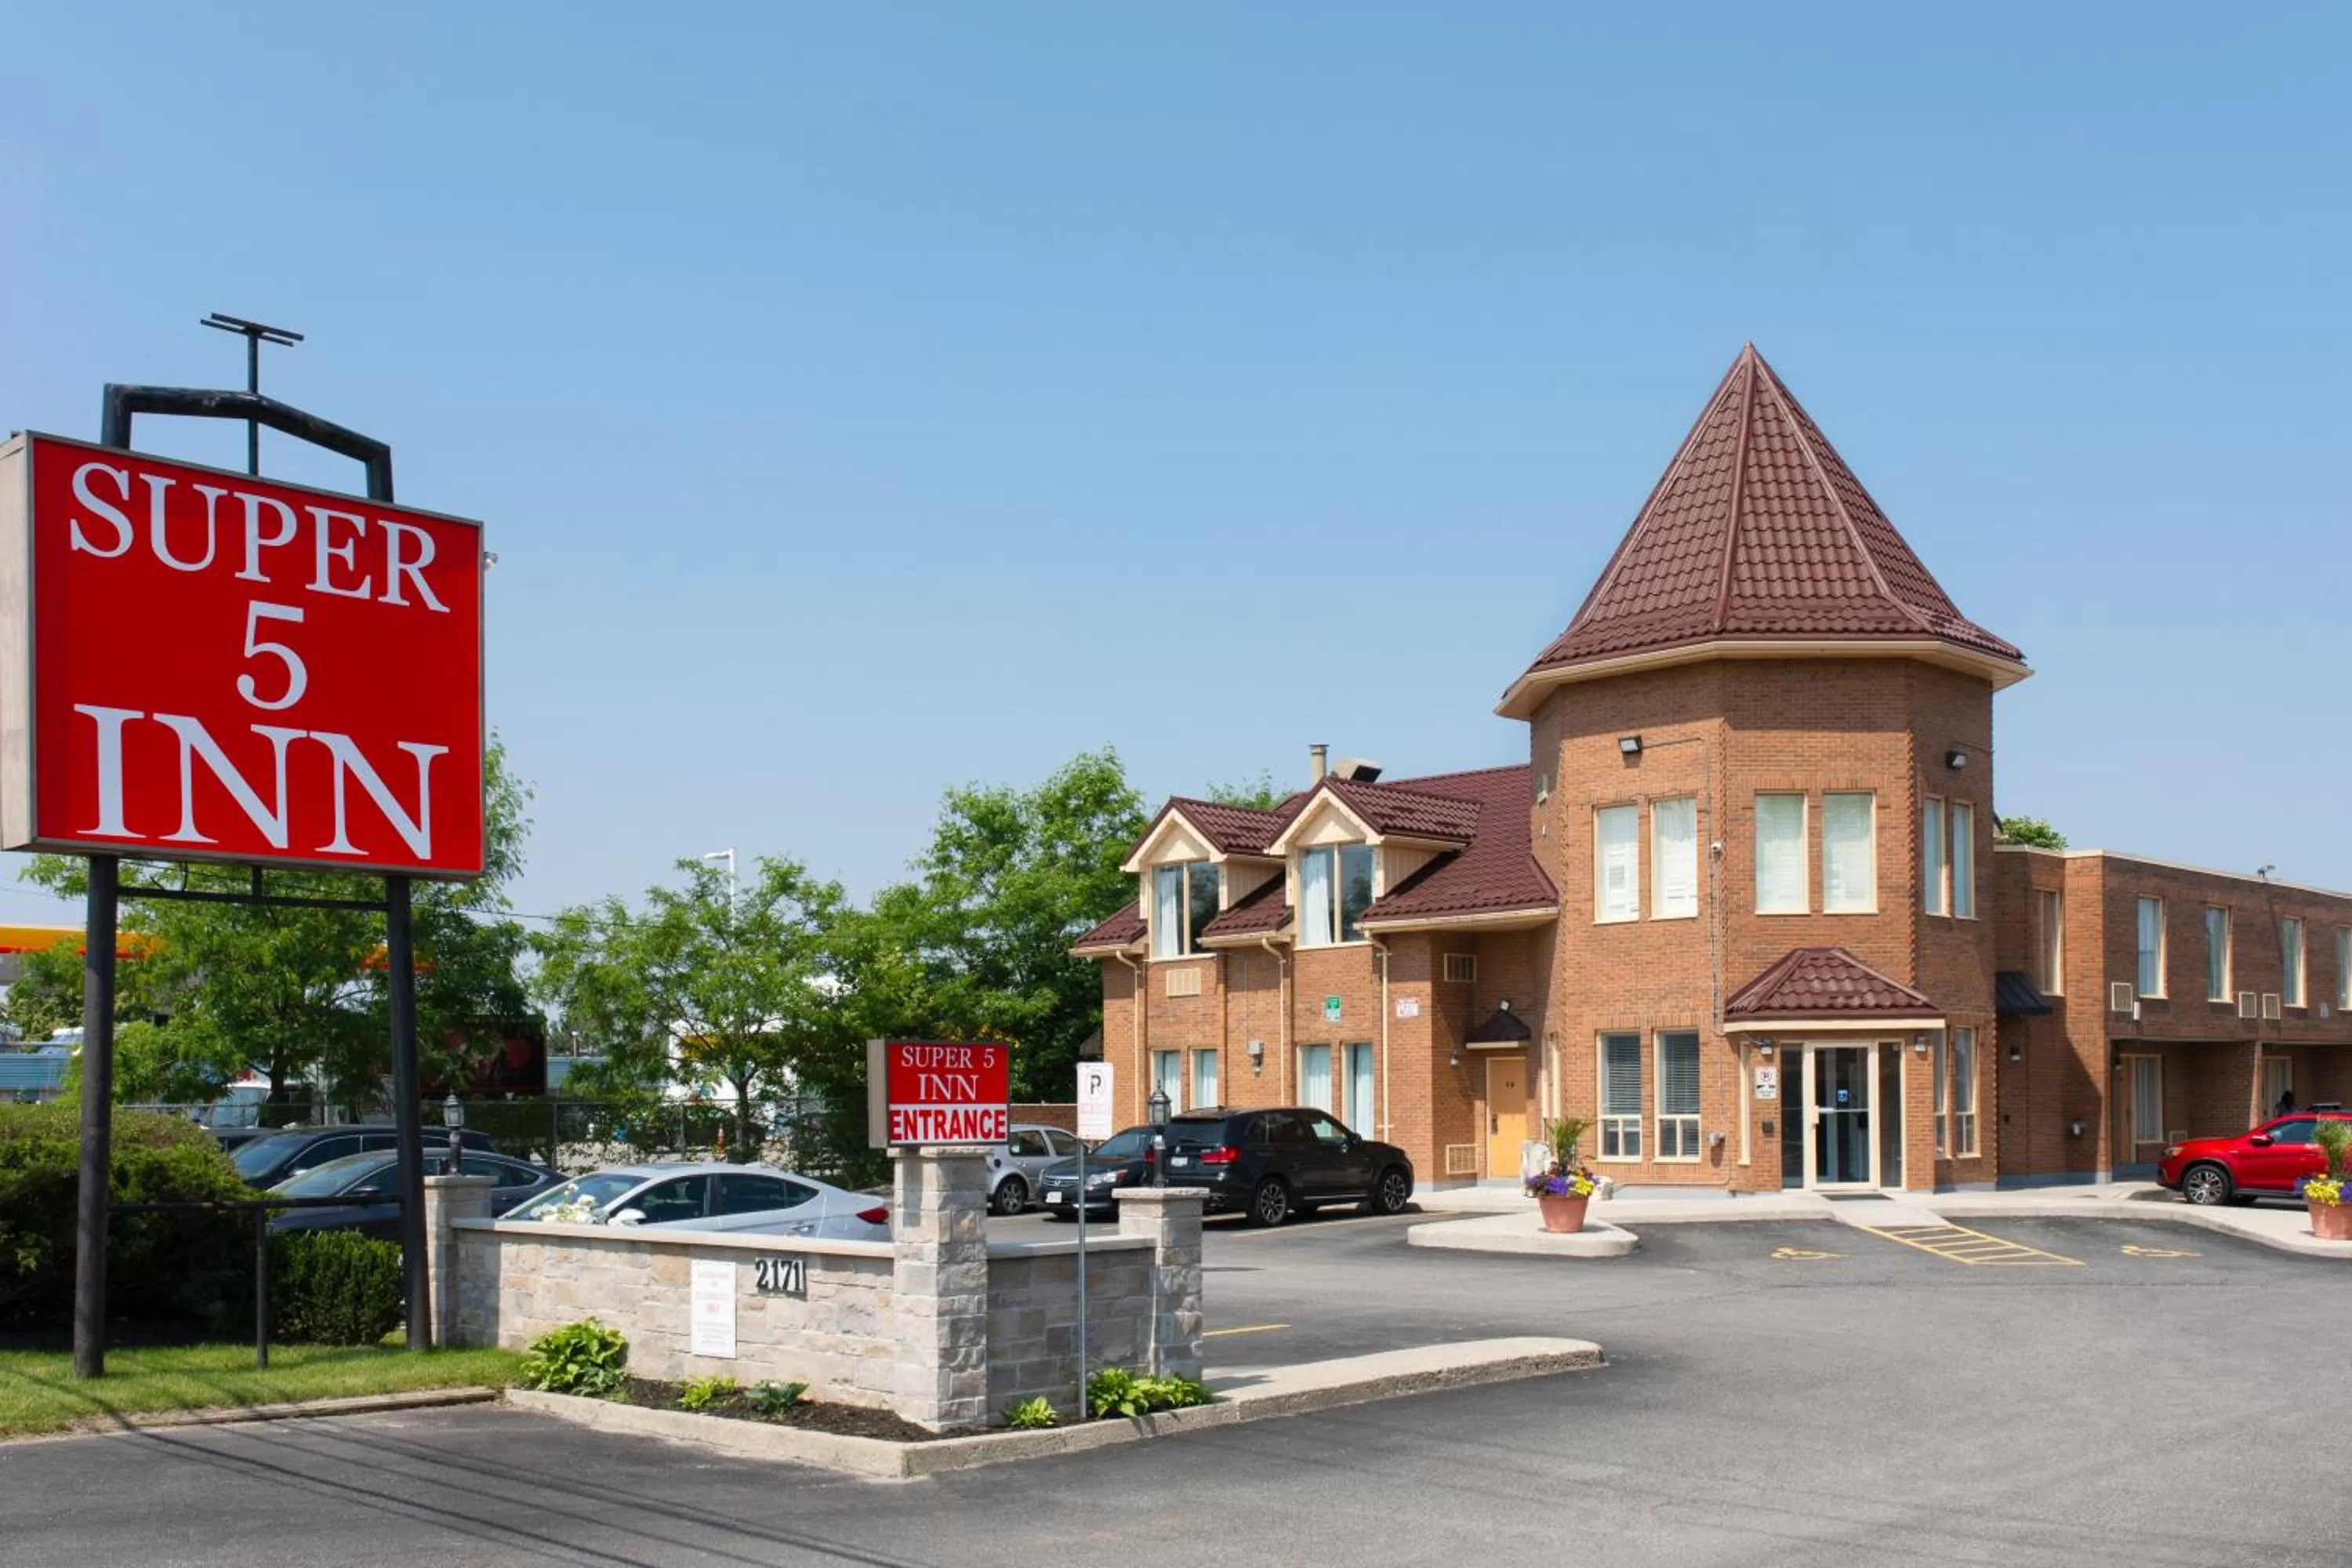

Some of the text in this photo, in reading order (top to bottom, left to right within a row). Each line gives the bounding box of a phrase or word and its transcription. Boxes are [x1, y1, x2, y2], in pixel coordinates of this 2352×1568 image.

[70, 463, 450, 613] SUPER
[236, 600, 307, 710] 5
[74, 703, 449, 860] INN
[901, 1045, 994, 1069] SUPER 5
[916, 1073, 979, 1101] INN
[1091, 1074, 1102, 1094] P
[890, 1109, 1006, 1141] ENTRANCE
[755, 1259, 801, 1291] 2171
